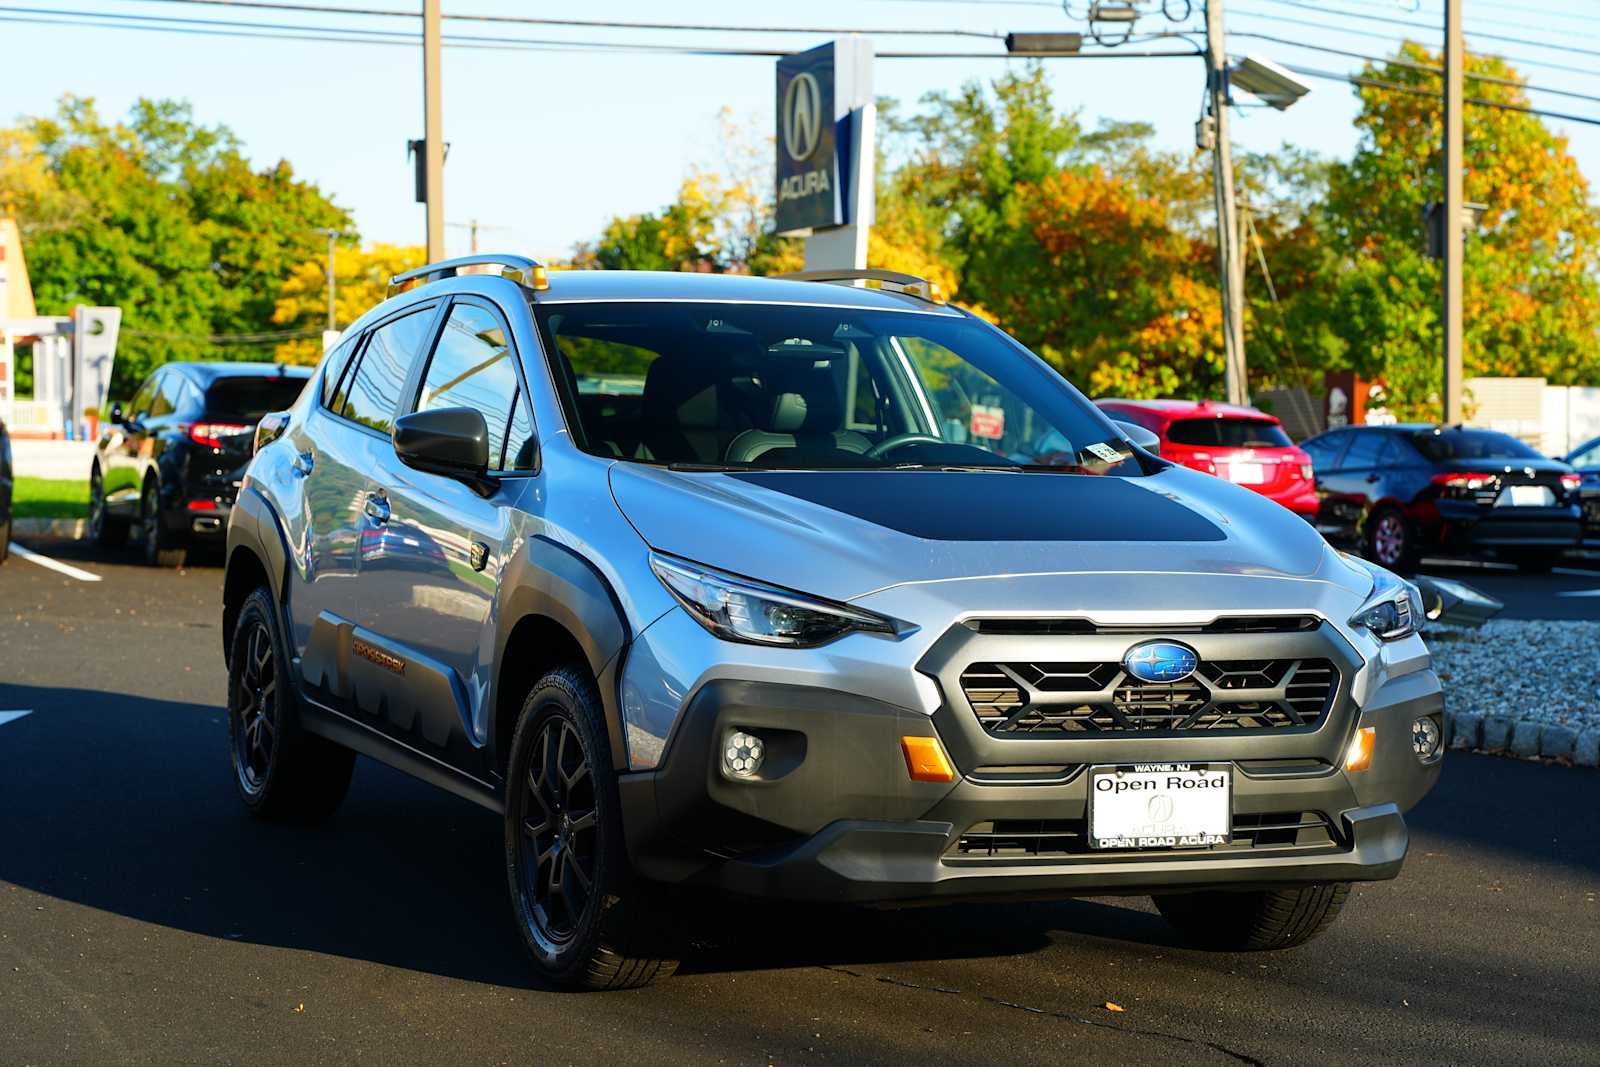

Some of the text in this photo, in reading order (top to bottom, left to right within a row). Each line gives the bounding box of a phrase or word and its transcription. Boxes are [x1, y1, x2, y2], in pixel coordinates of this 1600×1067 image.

[781, 168, 829, 200] ACURA
[1096, 775, 1224, 794] Open Road
[1100, 835, 1225, 848] OPEN ROAD ACURA
